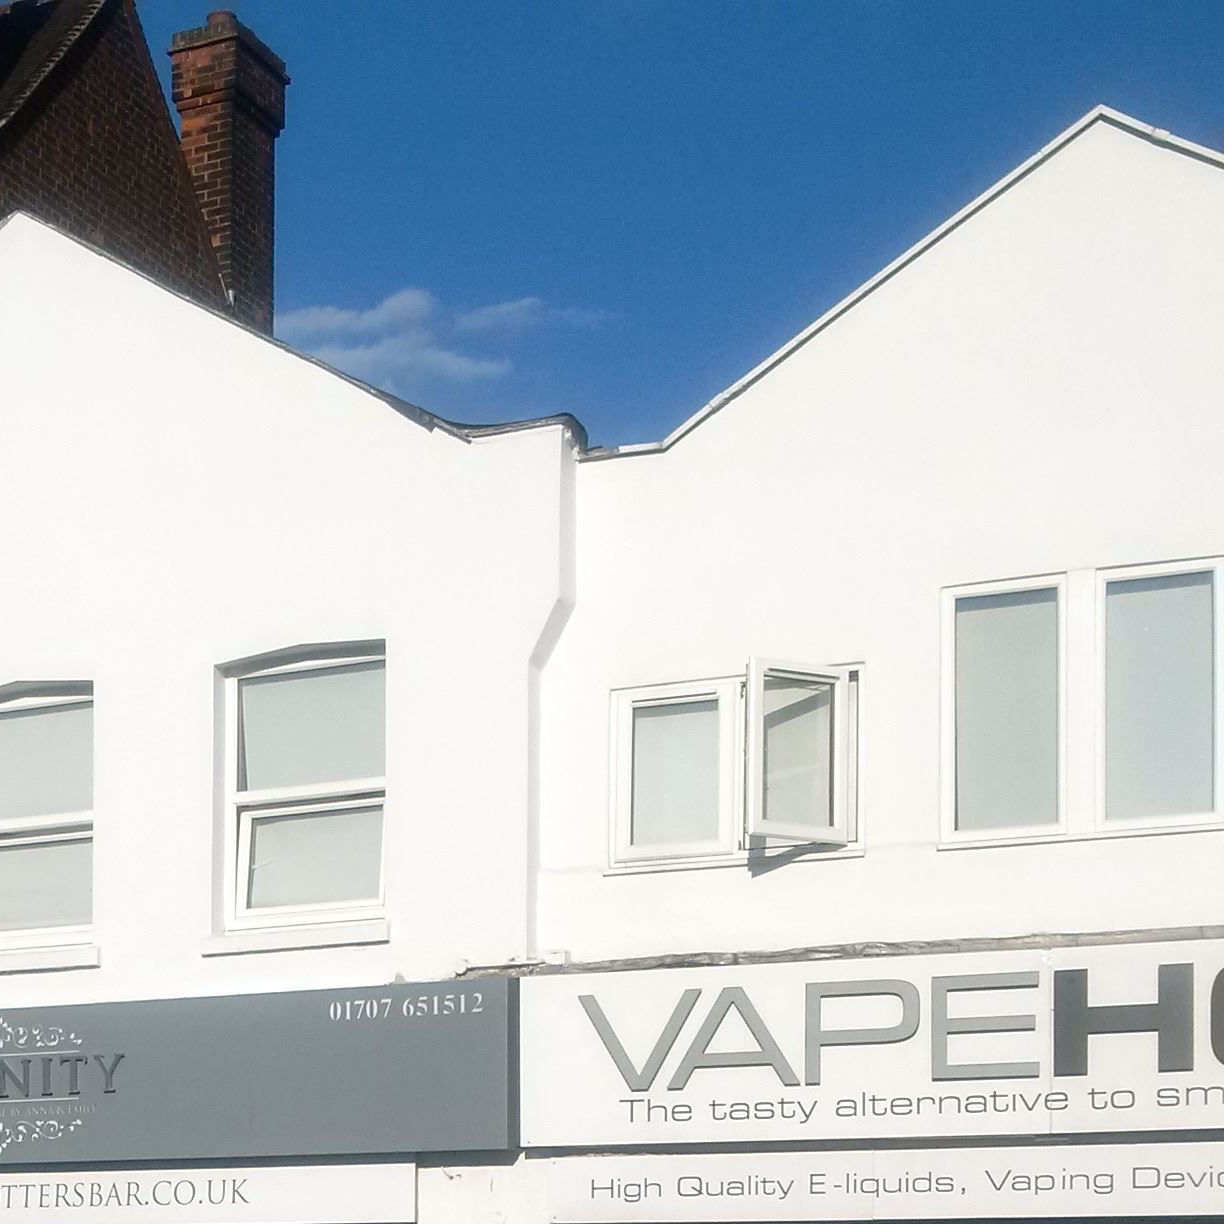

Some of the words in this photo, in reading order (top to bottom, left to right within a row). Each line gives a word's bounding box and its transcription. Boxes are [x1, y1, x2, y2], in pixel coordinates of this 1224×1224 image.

[329, 998, 393, 1022] 01707
[402, 992, 484, 1017] 651512
[578, 962, 1224, 1093] VAPEH
[619, 1099, 693, 1123] The
[709, 1097, 818, 1124] tasty
[835, 1086, 1069, 1117] alternative
[1087, 1087, 1136, 1110] to
[1156, 1086, 1224, 1108] sm
[590, 1178, 663, 1203] High
[676, 1172, 795, 1200] Quality
[984, 1167, 1114, 1196] Vaping
